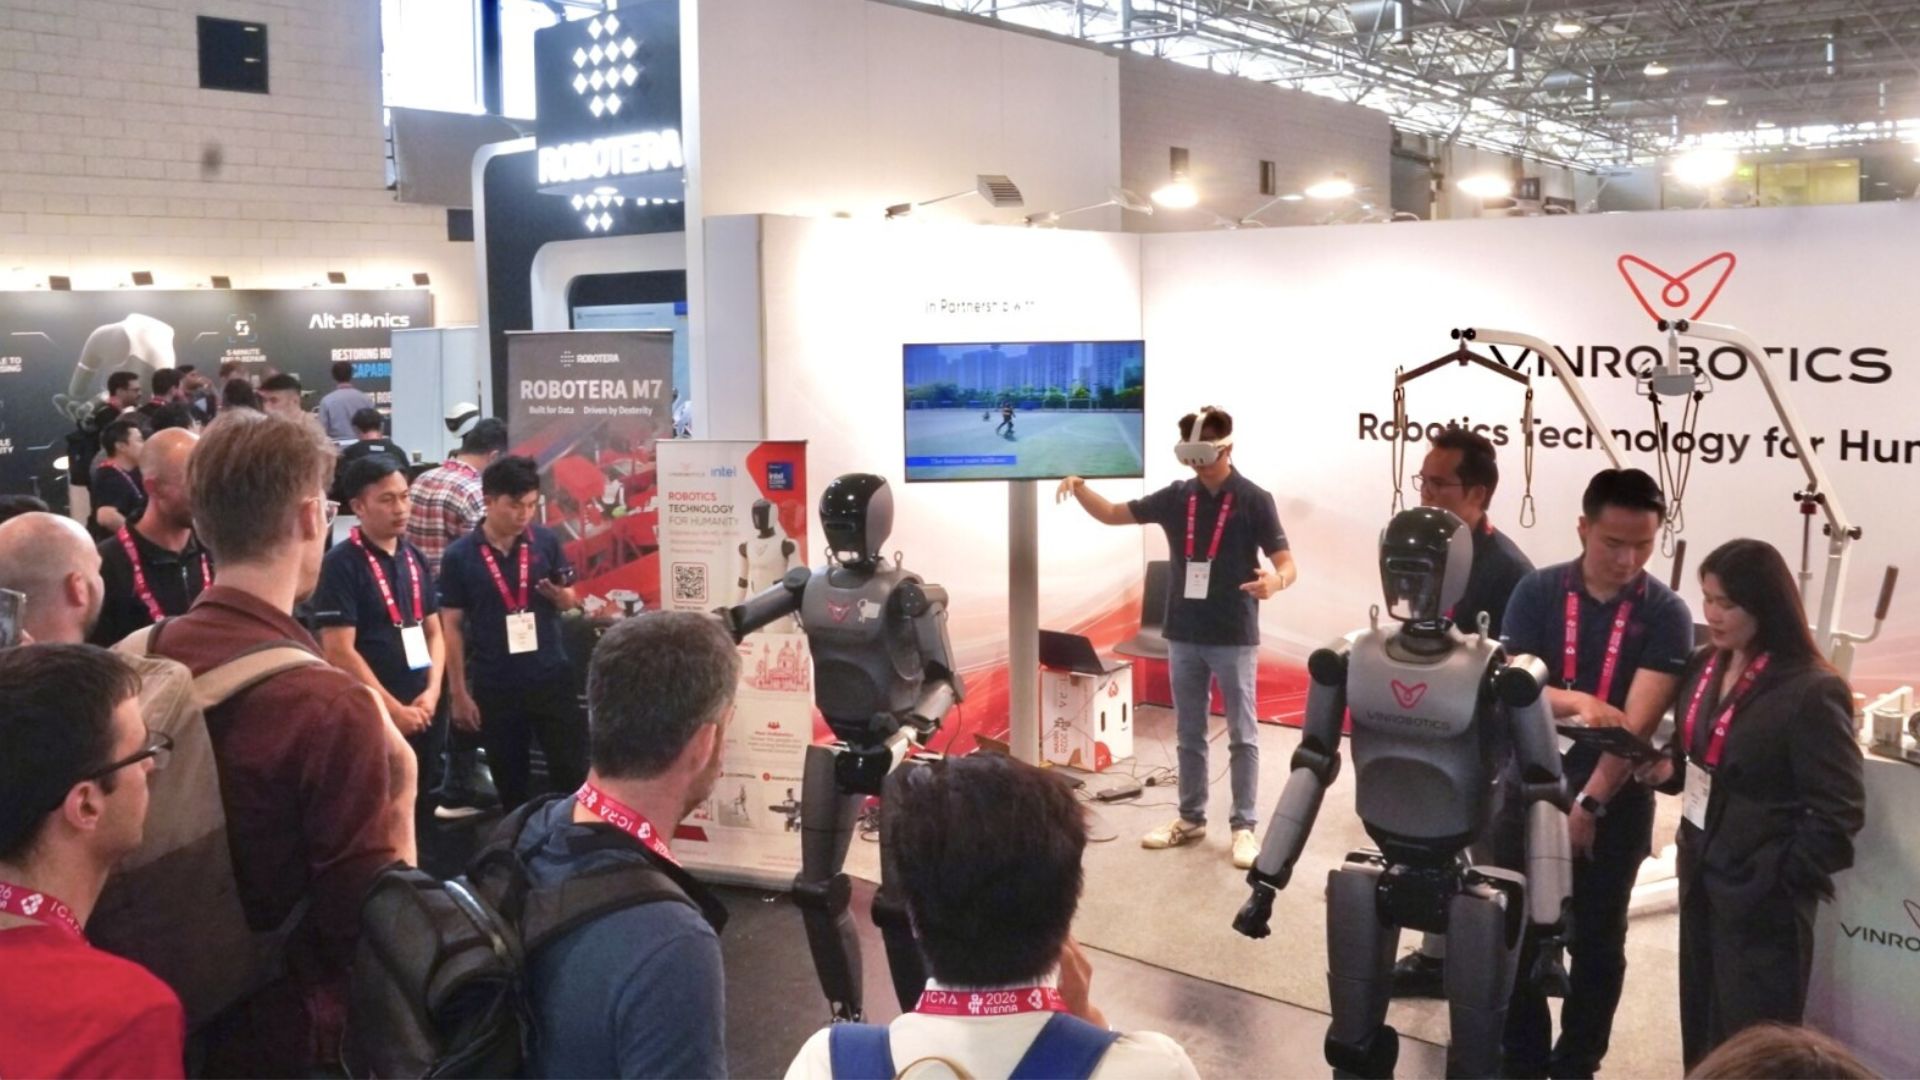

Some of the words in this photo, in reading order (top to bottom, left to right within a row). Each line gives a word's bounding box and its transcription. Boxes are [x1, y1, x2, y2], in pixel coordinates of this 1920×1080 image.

[538, 129, 683, 184] ROBOTERA
[331, 348, 378, 361] RESTORING
[576, 353, 620, 364] ROBOTERA
[1489, 345, 1893, 384] VINROBOICS
[520, 380, 628, 399] ROBOTERA
[632, 379, 663, 399] M7
[558, 406, 575, 415] Data
[583, 406, 607, 415] Driven
[608, 406, 618, 416] by
[618, 406, 653, 416] Dexterity
[710, 465, 736, 477] intel
[668, 492, 717, 501] ROBOTICS
[668, 504, 735, 514] TECHNOLOGY
[668, 515, 689, 526] FOR
[690, 516, 739, 527] HUMANITY
[1367, 711, 1450, 730] VINROBOTICS
[600, 804, 634, 832] ICRA
[926, 991, 959, 1005] ICRA
[986, 992, 1017, 1004] 2026
